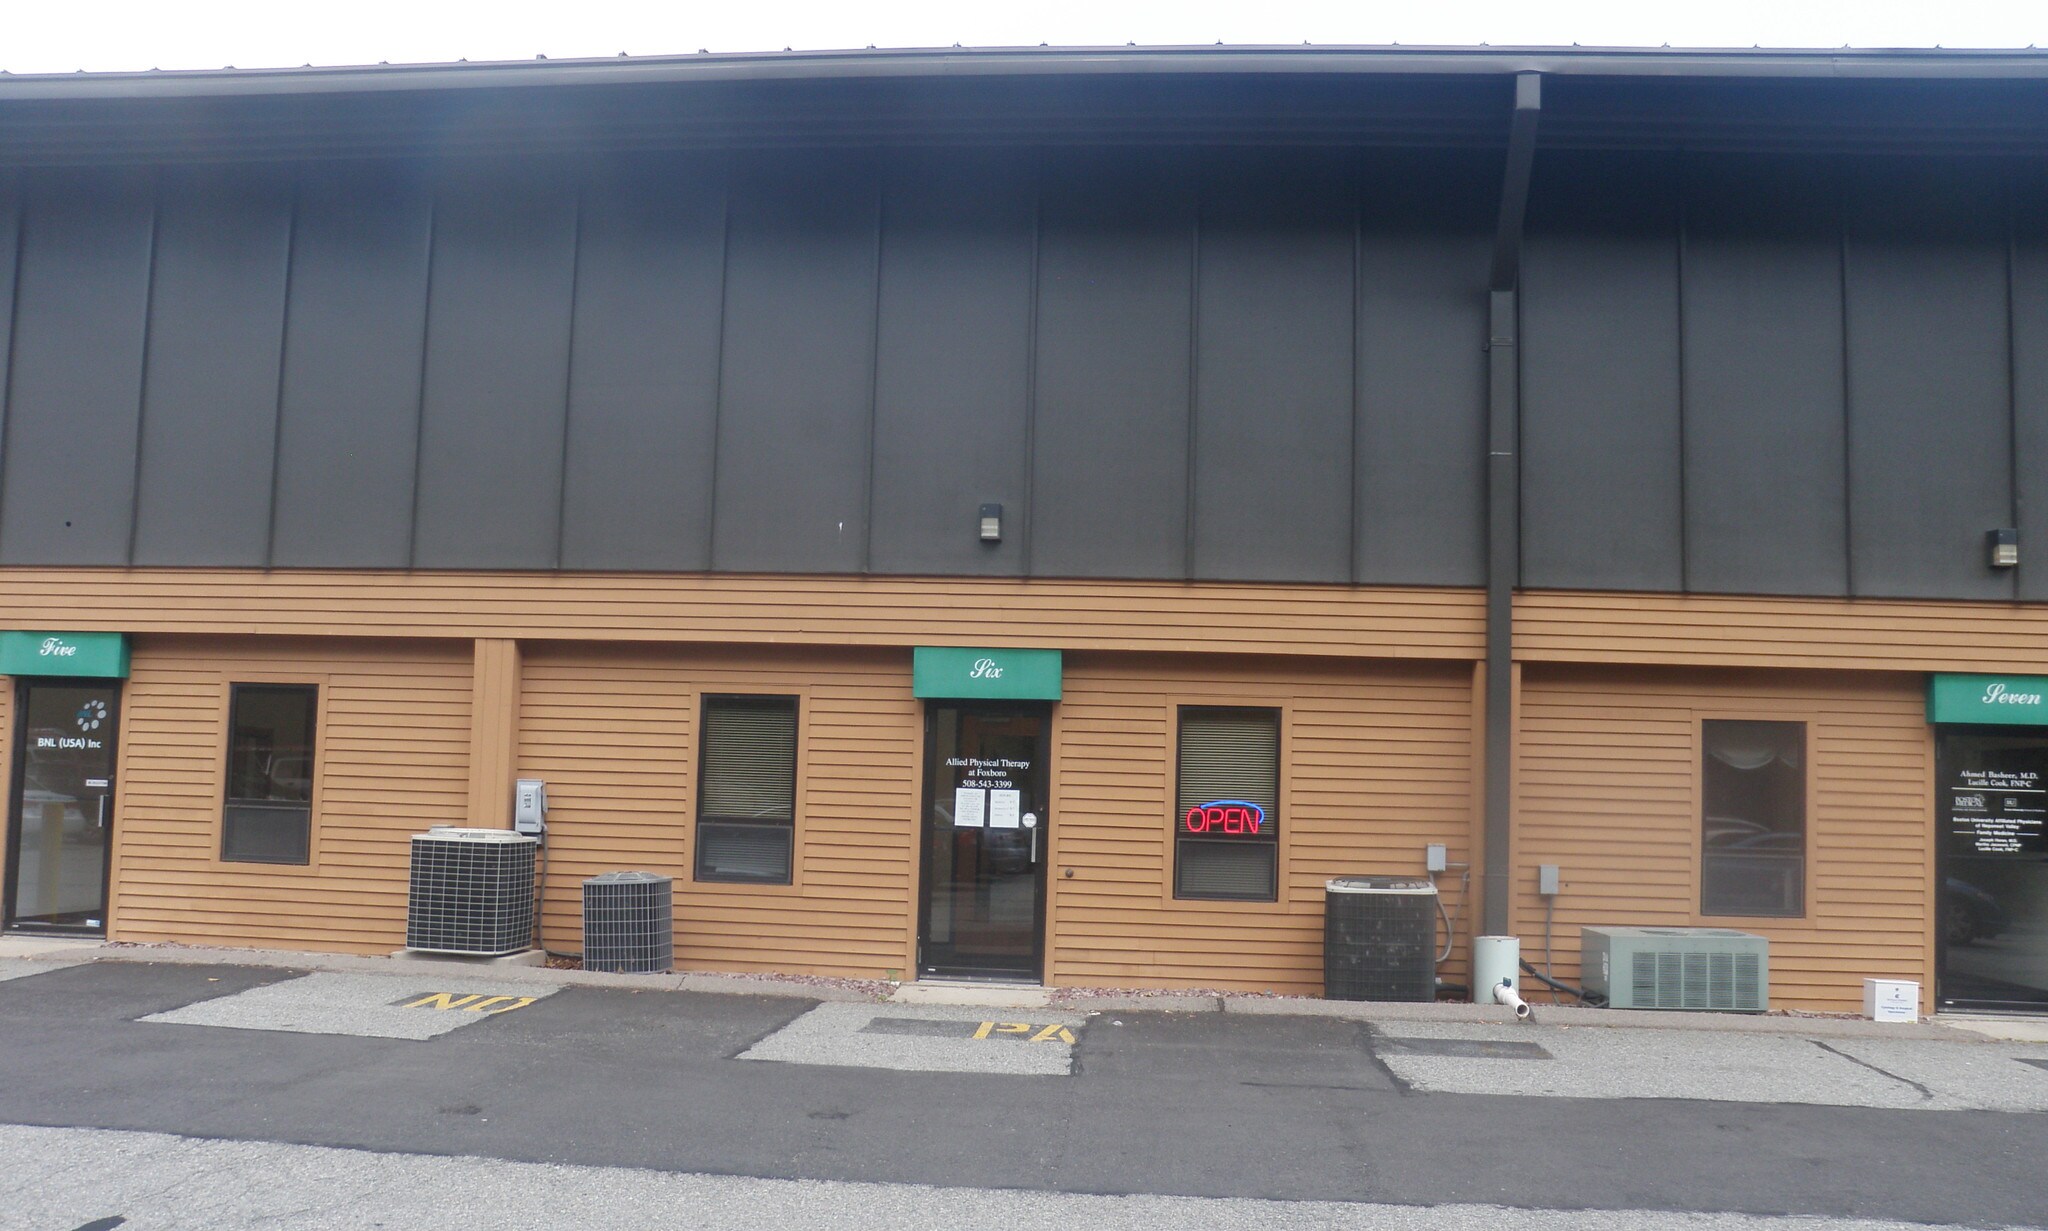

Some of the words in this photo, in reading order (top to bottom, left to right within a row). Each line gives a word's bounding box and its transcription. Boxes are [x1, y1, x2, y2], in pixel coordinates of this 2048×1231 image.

[40, 637, 77, 656] Five
[969, 658, 1004, 679] Six
[1981, 683, 2042, 705] Seven
[37, 738, 56, 748] BNL
[59, 737, 85, 750] (USA)
[88, 739, 102, 749] Inc
[945, 758, 968, 767] Allied
[969, 758, 999, 768] Physical
[1000, 759, 1030, 770] Therapy
[976, 769, 1007, 778] Foxboro
[1960, 770, 1986, 778] Ahmed
[2020, 772, 2039, 780] M.D.
[962, 779, 1012, 789] 508-543-3399
[1968, 778, 1989, 786] Lucille
[1186, 807, 1259, 833] OPEN
